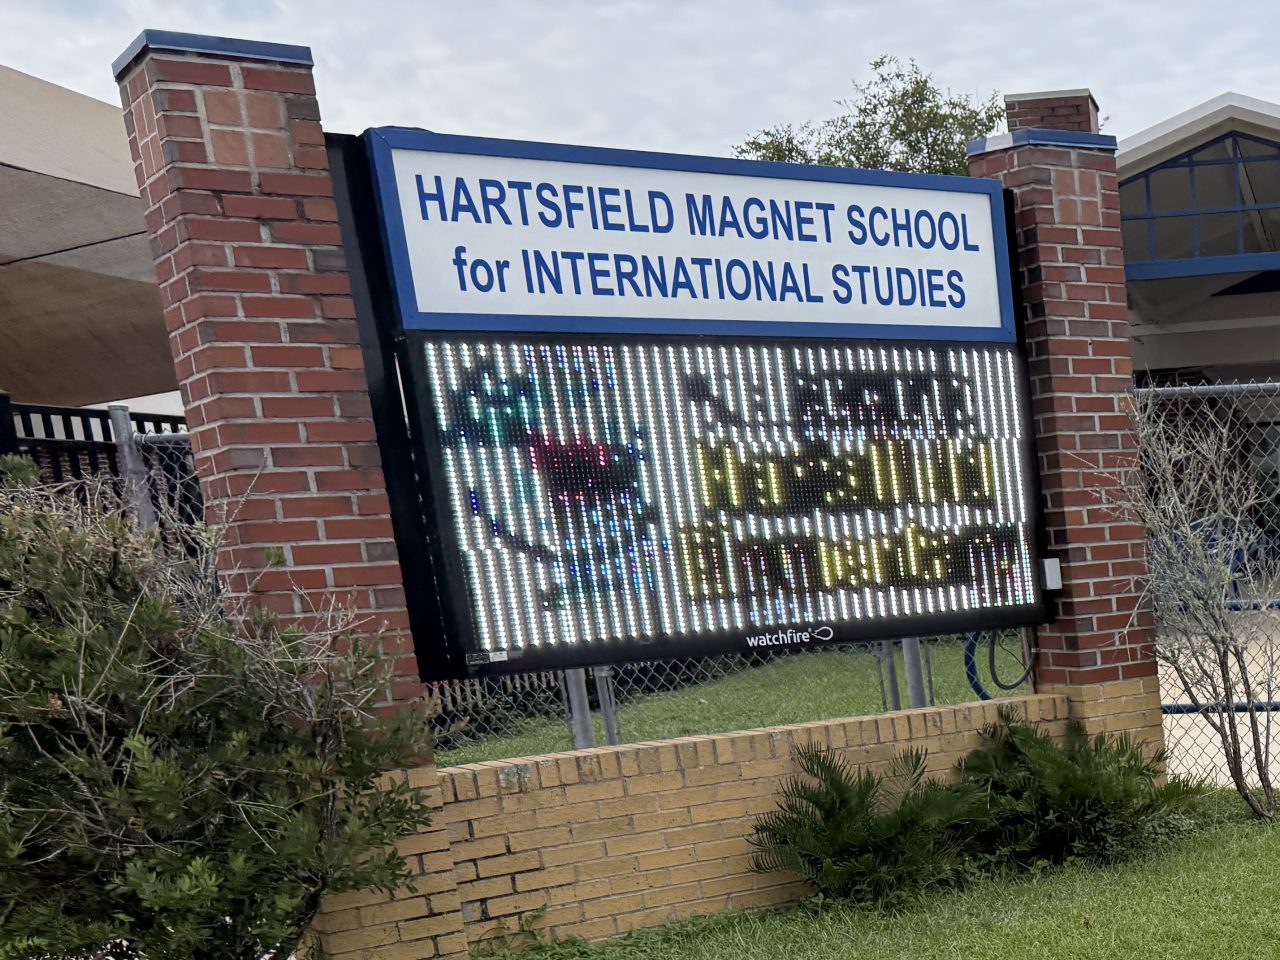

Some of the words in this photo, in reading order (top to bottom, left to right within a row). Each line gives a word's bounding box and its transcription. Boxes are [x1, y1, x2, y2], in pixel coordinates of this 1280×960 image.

[415, 174, 675, 234] HARTSFIELD
[686, 193, 835, 244] MAGNET
[847, 204, 981, 252] SCHOOL
[452, 245, 511, 293] for
[521, 248, 824, 305] INTERNATIONAL
[831, 264, 967, 309] STUDIES
[746, 628, 810, 648] watchfire
